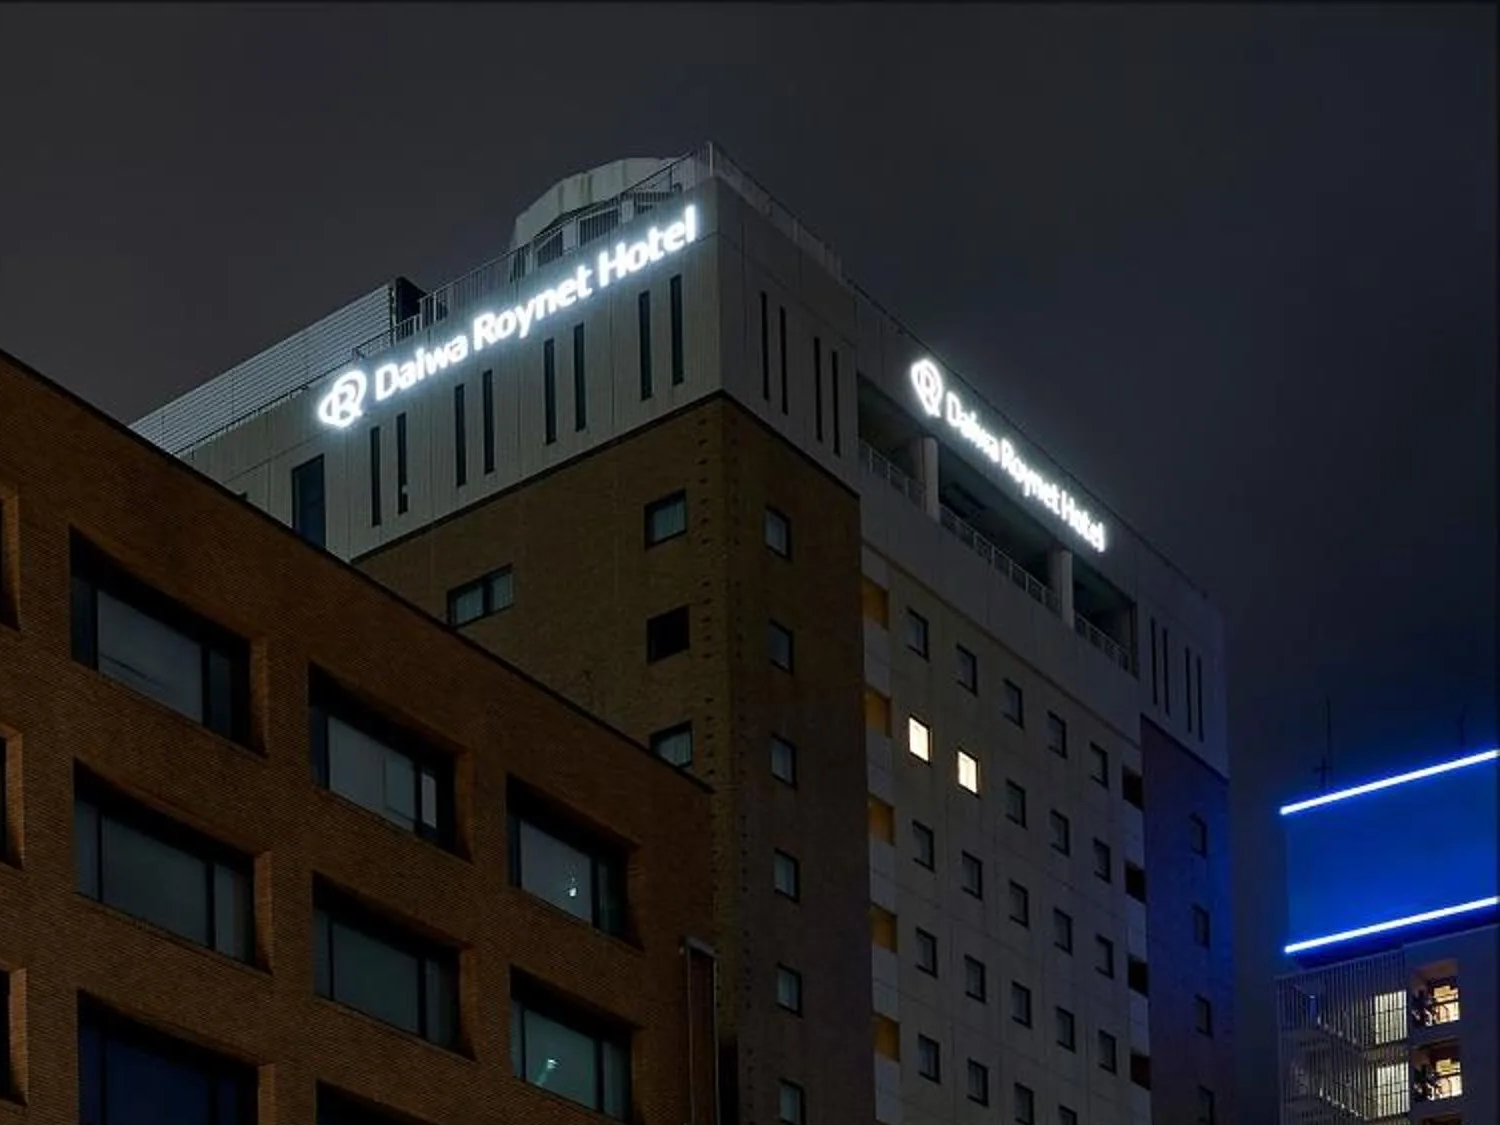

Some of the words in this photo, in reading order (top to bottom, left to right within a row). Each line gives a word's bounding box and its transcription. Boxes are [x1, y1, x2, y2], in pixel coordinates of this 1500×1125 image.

[375, 334, 468, 402] Daiwa
[473, 264, 592, 351] Roynet
[599, 204, 697, 288] Hotel
